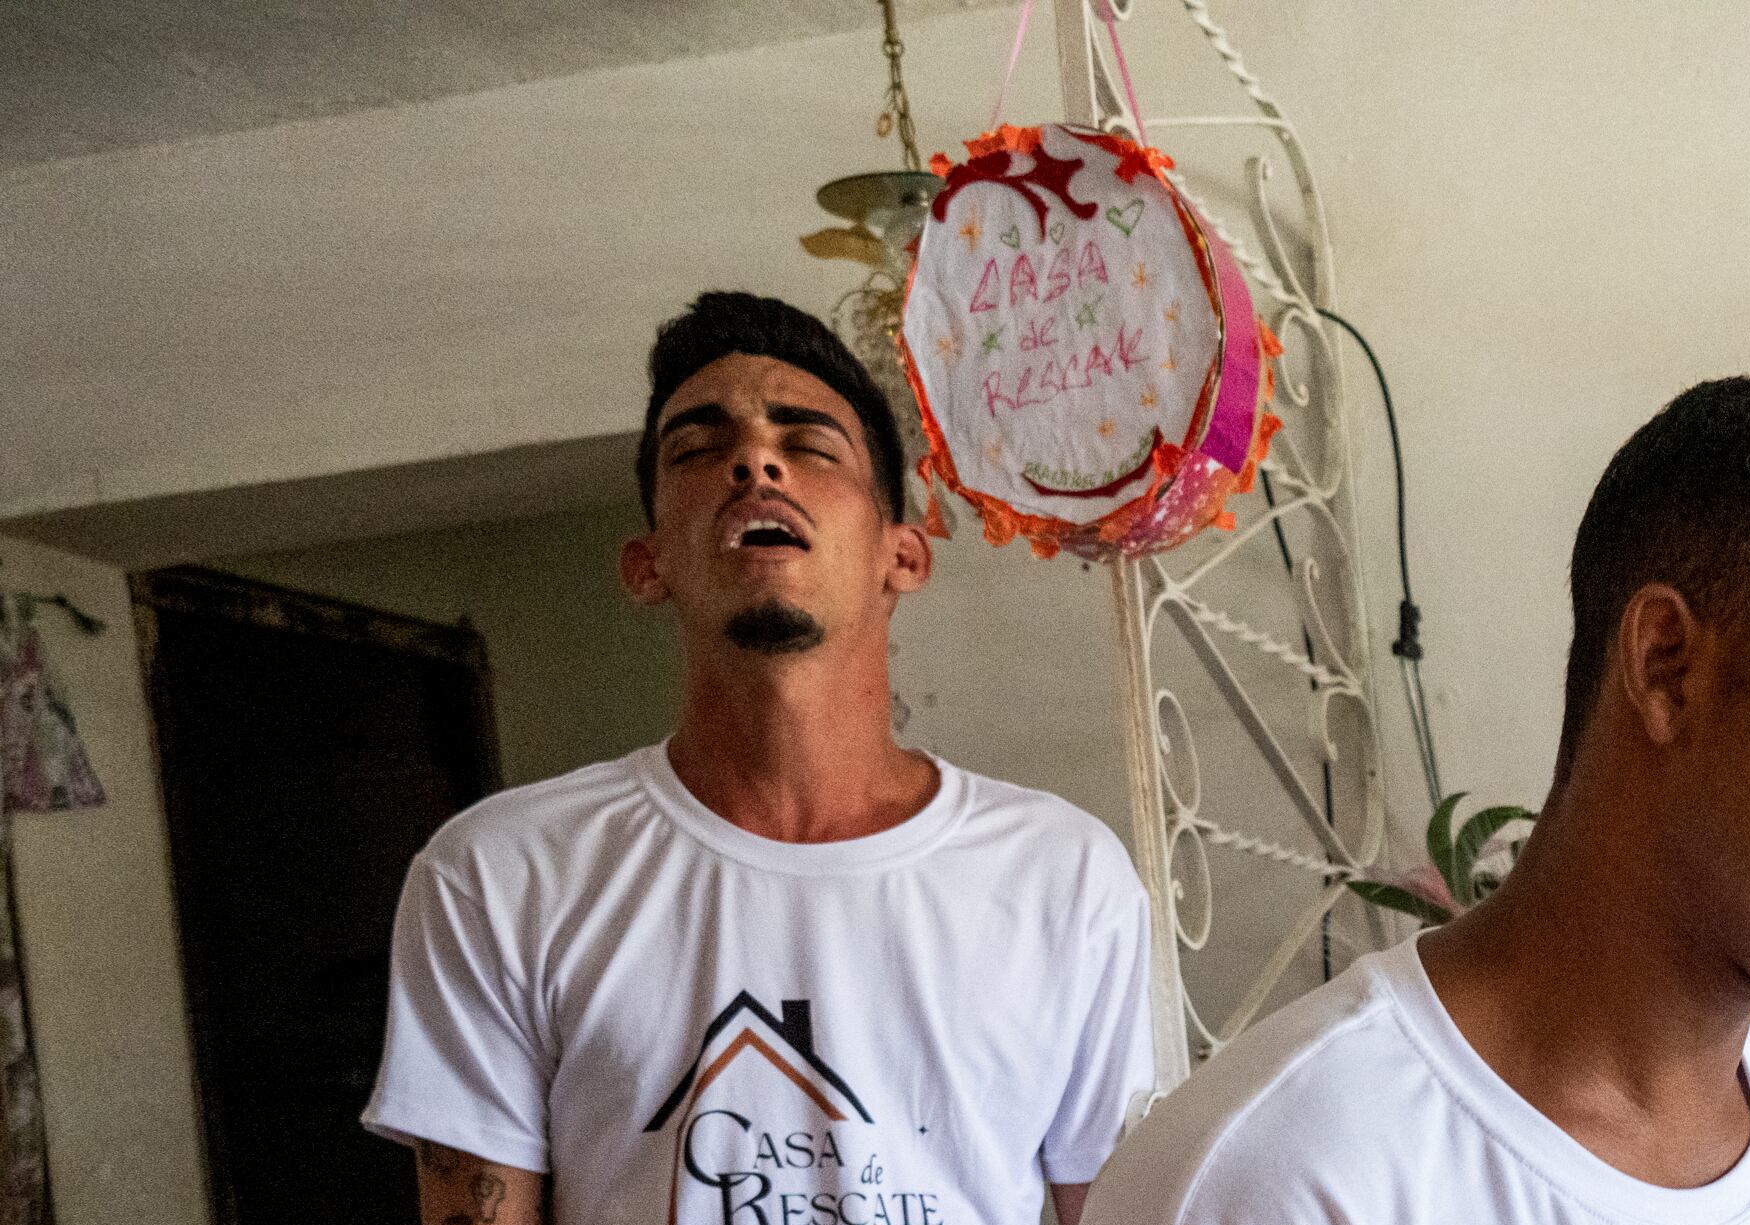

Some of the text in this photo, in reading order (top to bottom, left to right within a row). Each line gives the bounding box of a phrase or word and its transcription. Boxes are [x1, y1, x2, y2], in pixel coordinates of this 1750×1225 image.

[969, 240, 1109, 313] CASA
[684, 1109, 884, 1188] CASA de
